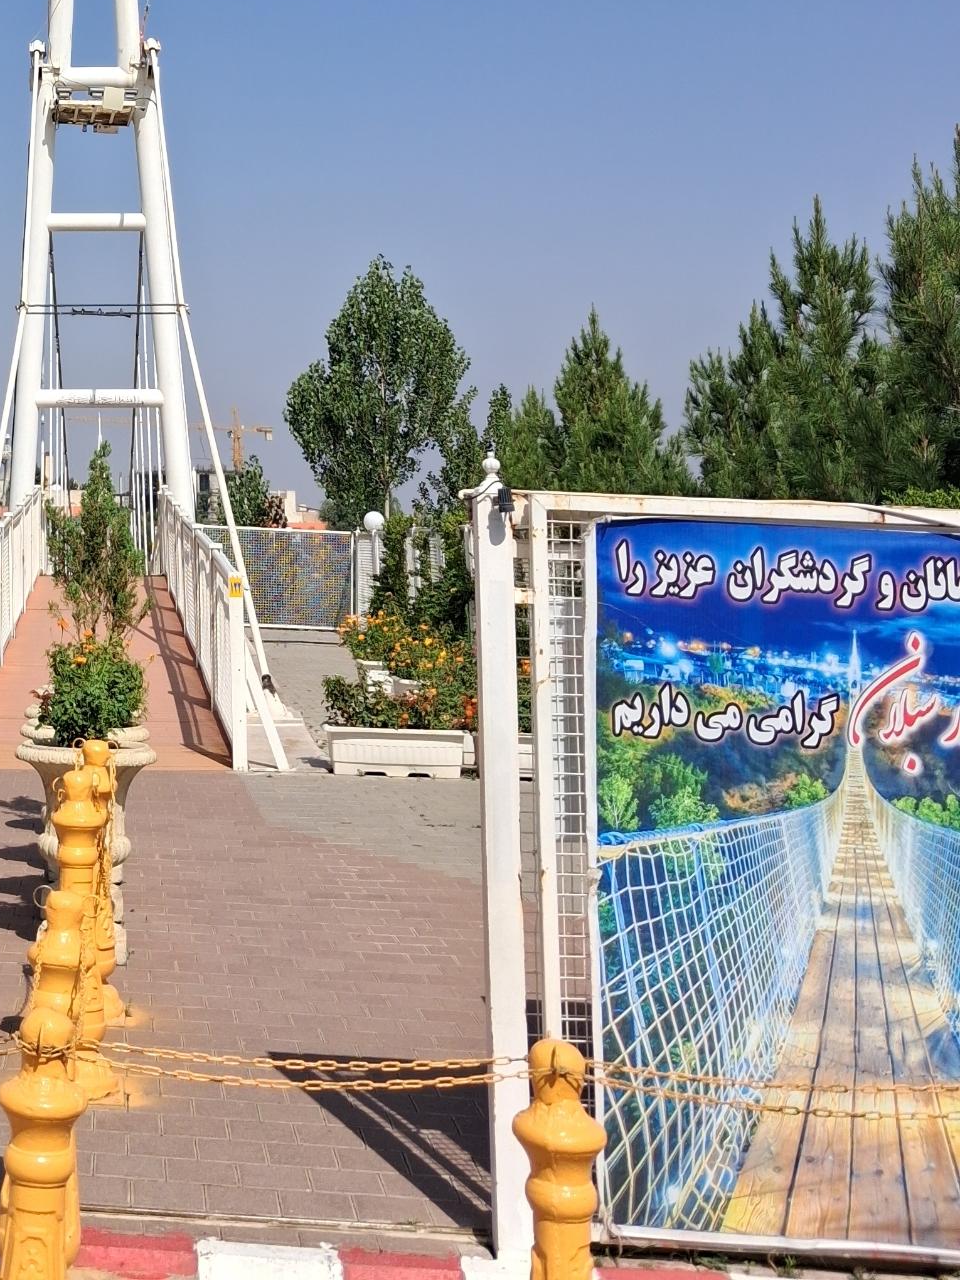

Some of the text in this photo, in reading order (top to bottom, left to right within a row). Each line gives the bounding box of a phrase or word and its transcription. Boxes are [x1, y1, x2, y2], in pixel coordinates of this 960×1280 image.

[616, 539, 646, 595] را
[651, 551, 716, 597] عزیز
[727, 547, 872, 608] گردشگران
[877, 571, 895, 611] و
[612, 683, 840, 747] گرامی می داریم
